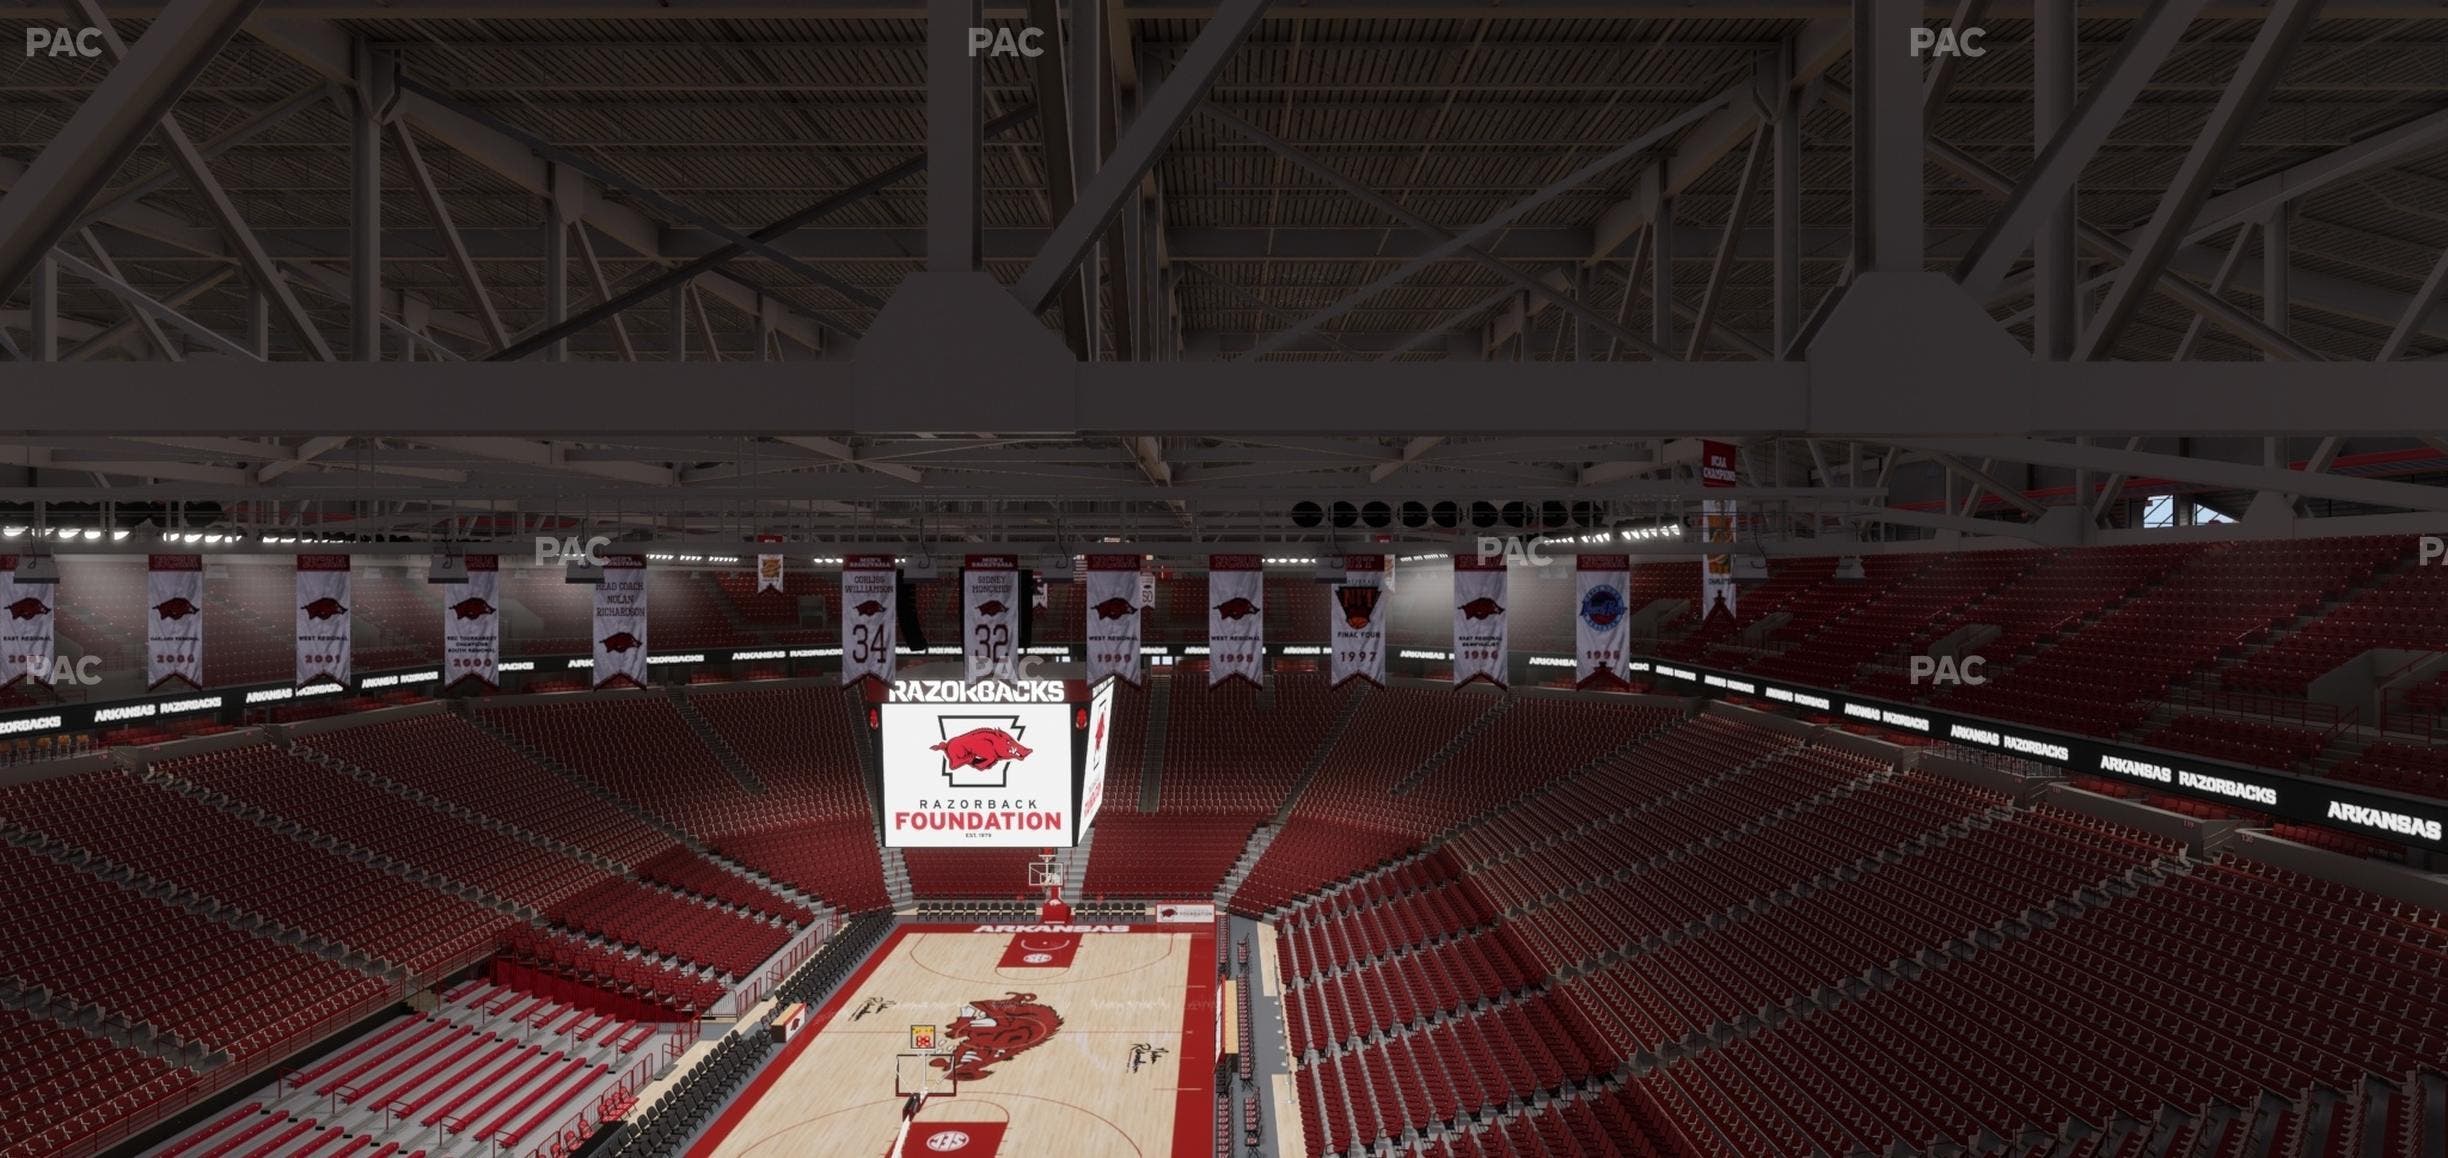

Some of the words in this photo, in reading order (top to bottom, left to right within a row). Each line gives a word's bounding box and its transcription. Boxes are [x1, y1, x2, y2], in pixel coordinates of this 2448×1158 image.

[852, 623, 886, 664] 34
[975, 623, 1008, 663] 32
[305, 654, 341, 664] 2001
[453, 658, 492, 668] 2000
[1097, 654, 1132, 663] 1999
[1340, 651, 1377, 662] 1997
[94, 704, 156, 722] ARKANSAS
[160, 697, 222, 714] RAZORBACKS
[1950, 724, 2000, 747] ARKANSAS
[2003, 735, 2069, 761] RAZORBACKS
[2100, 755, 2172, 783] ARKANSAS
[2178, 770, 2277, 805] RAZORBACKS
[919, 799, 1038, 809] RAZORBACK
[895, 812, 1062, 830] FOUNDATION
[2327, 800, 2442, 841] ARKANSAS
[973, 925, 1130, 933] ARKANSAS
